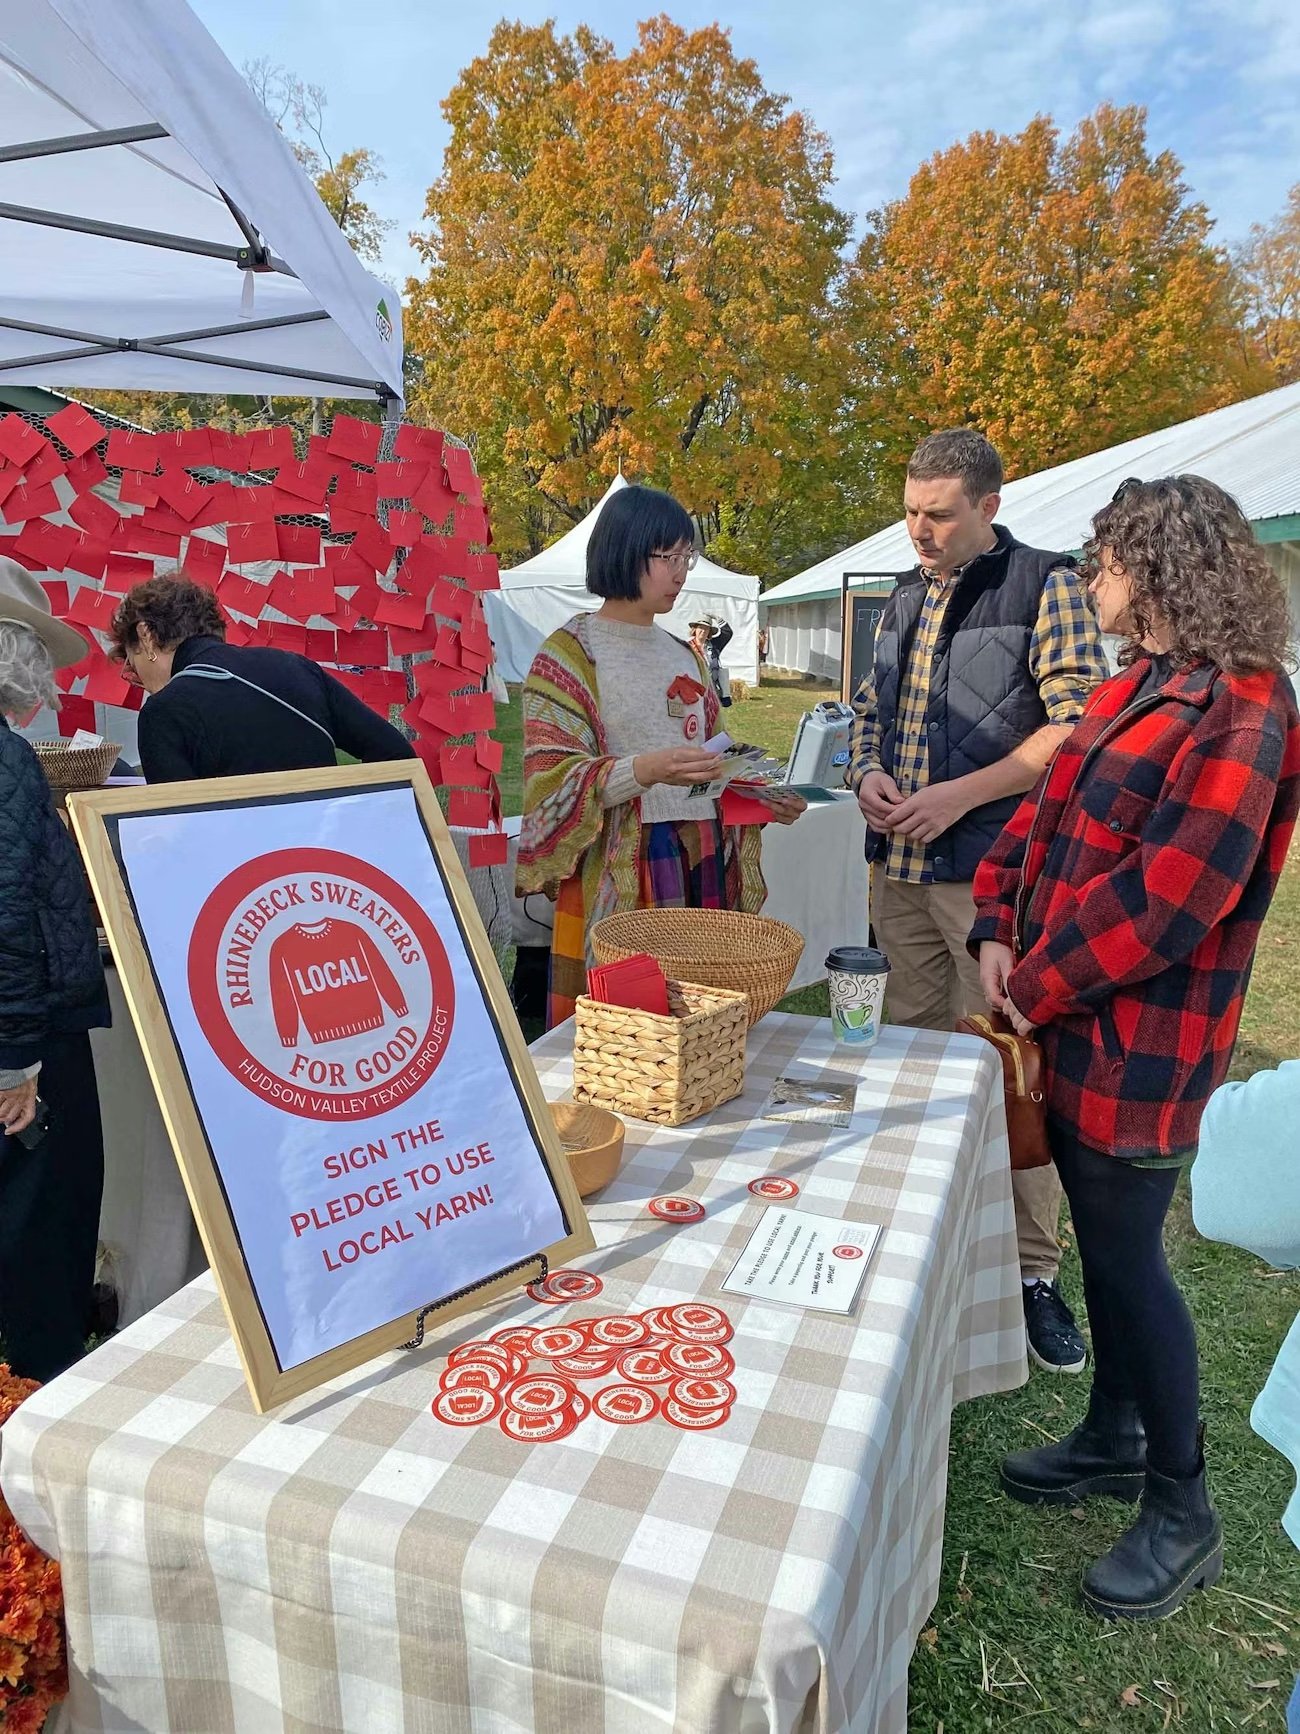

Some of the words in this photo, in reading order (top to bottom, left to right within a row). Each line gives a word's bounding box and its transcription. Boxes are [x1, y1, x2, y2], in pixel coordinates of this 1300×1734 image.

[856, 608, 885, 632] FR
[226, 883, 305, 1009] RHINEBECK
[310, 881, 420, 965] SWEATERS
[294, 956, 368, 996] LOCAL
[238, 1058, 306, 1108] HUDSON
[311, 1097, 368, 1114] VALLEY
[370, 1073, 422, 1107] TEXTILE
[417, 1006, 448, 1072] PROJECT
[289, 1053, 347, 1087] FOR
[356, 1026, 418, 1082] GOOD
[324, 1139, 388, 1179] SIGN
[391, 1120, 444, 1154] THE
[290, 1178, 402, 1238] PLEDGE
[404, 1164, 440, 1191] TO
[445, 1142, 495, 1176] USE
[322, 1220, 414, 1272] LOCAL
[415, 1184, 494, 1231] YARN!
[770, 1226, 782, 1238] LOCAL
[766, 1238, 775, 1246] USE
[754, 1253, 768, 1268] PLEDGE
[744, 1276, 755, 1285] TAKE
[750, 1268, 760, 1276] THE
[812, 1280, 820, 1294] THANK
[531, 1391, 548, 1399] LOCAL
[617, 1398, 635, 1406] LOCAL
